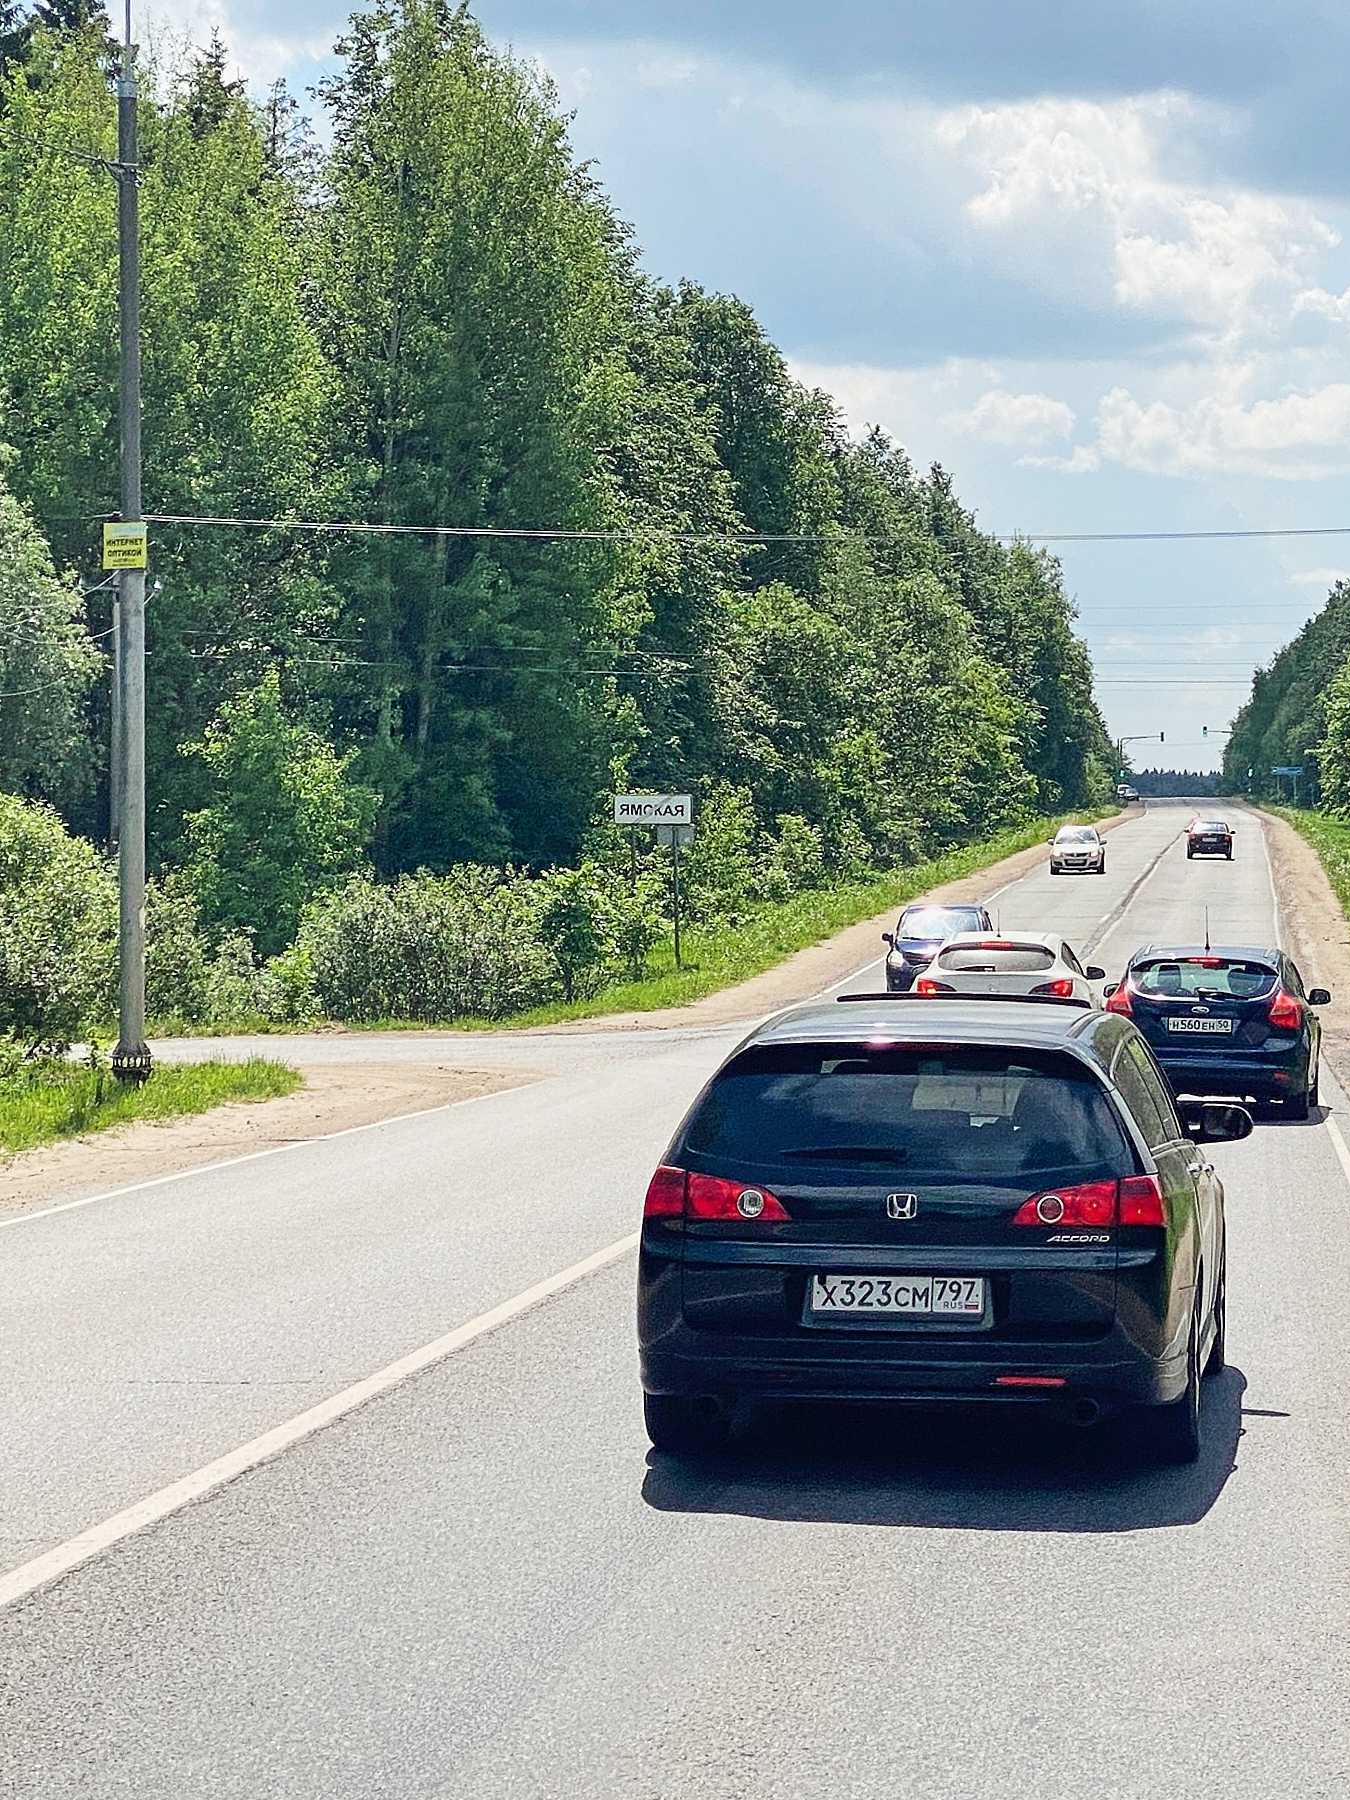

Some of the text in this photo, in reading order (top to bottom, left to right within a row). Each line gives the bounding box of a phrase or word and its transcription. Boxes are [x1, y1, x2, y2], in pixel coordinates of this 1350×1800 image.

[106, 538, 143, 546] ИНТЕРНЕТ
[619, 804, 684, 816] ЯМСКАЯ
[935, 1280, 976, 1301] 797
[943, 1302, 963, 1310] RUS
